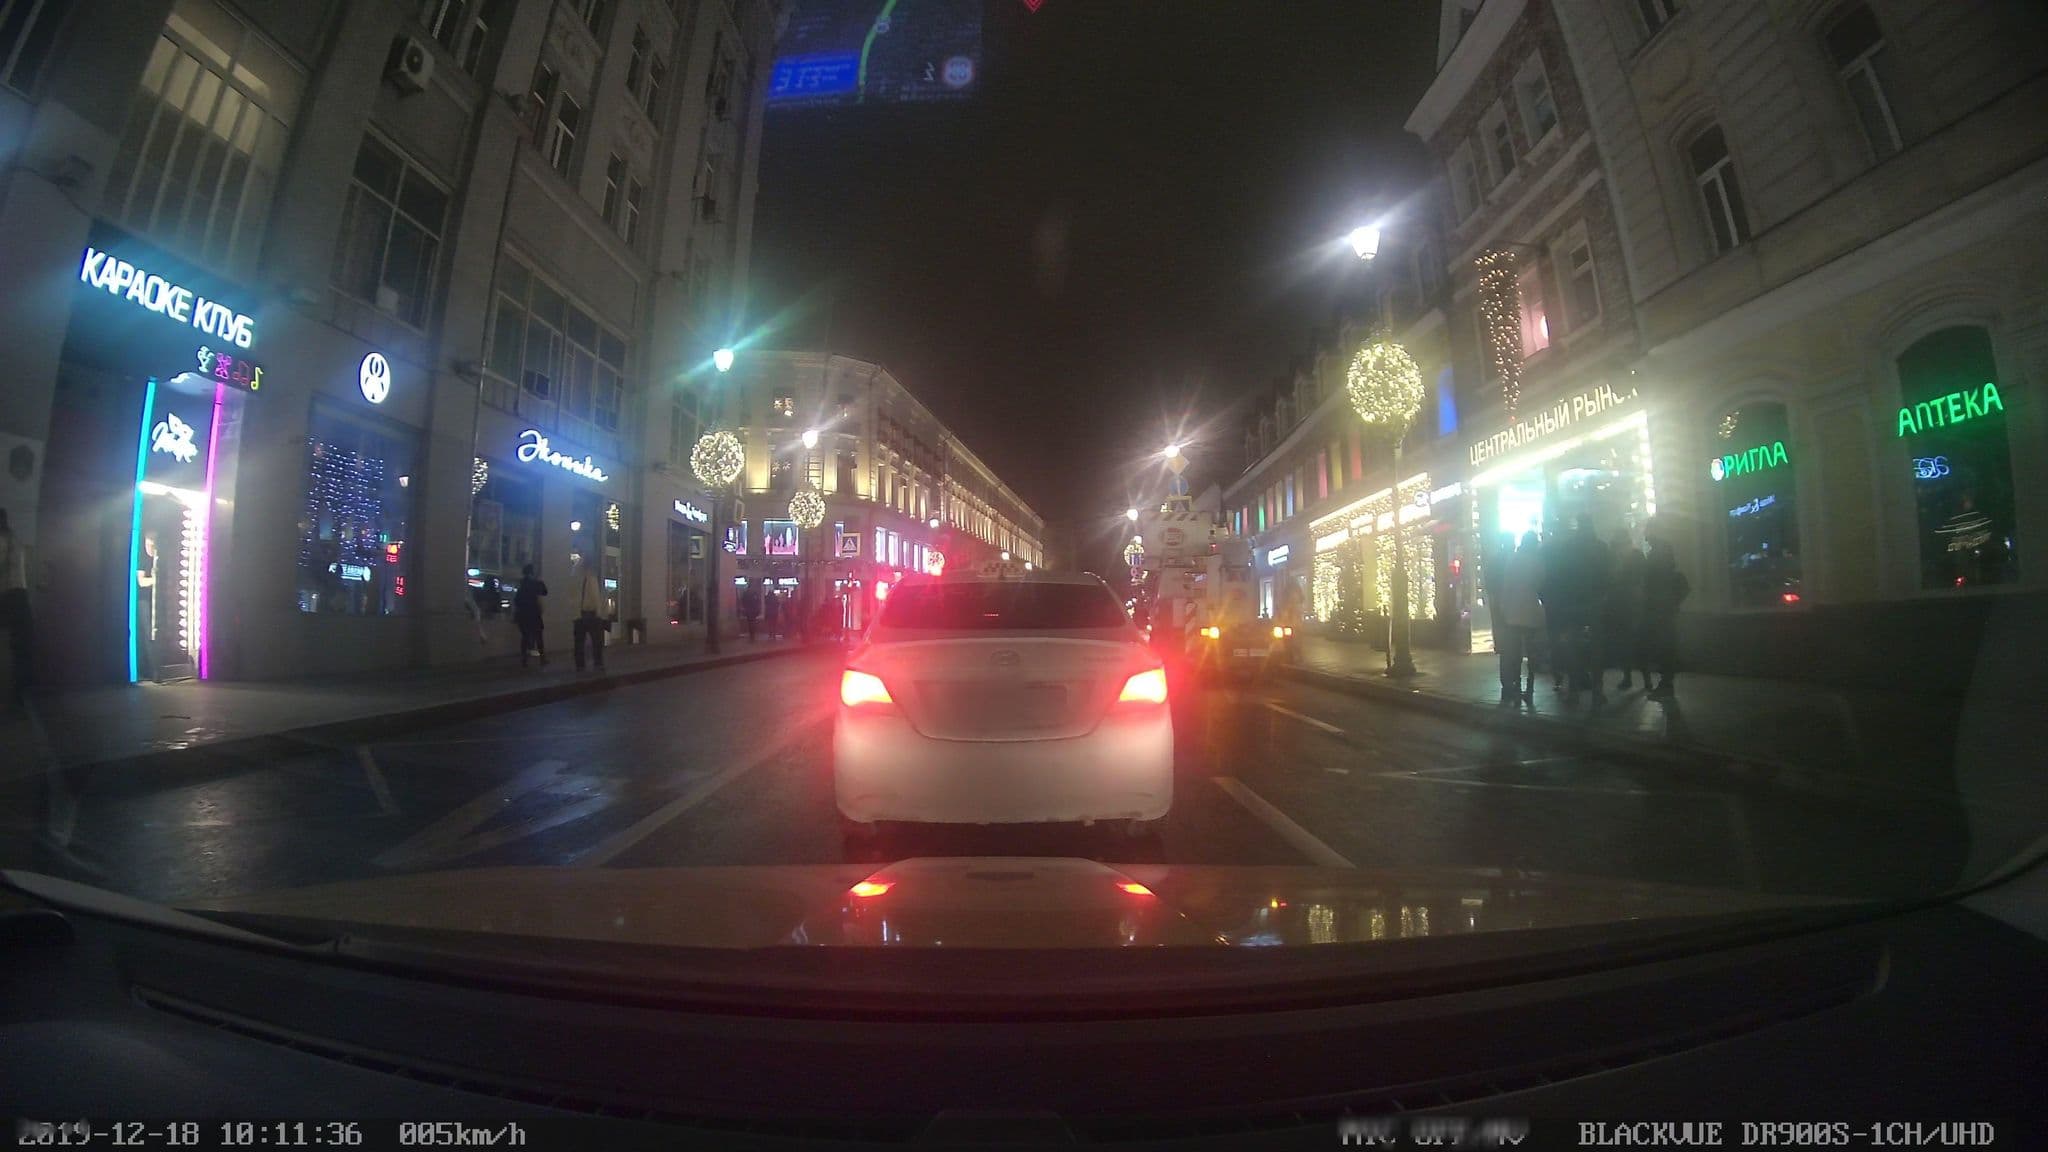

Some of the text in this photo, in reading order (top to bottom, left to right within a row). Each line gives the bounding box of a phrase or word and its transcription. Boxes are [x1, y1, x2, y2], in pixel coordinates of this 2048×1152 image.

[80, 247, 254, 349] КАРАОКЕ КЛУБ
[1469, 382, 1639, 467] ЦЕНТРАЛЬНЫЙ РЫН
[1898, 382, 2004, 437] АПТЕКА
[1723, 440, 1789, 479] РИГЛА
